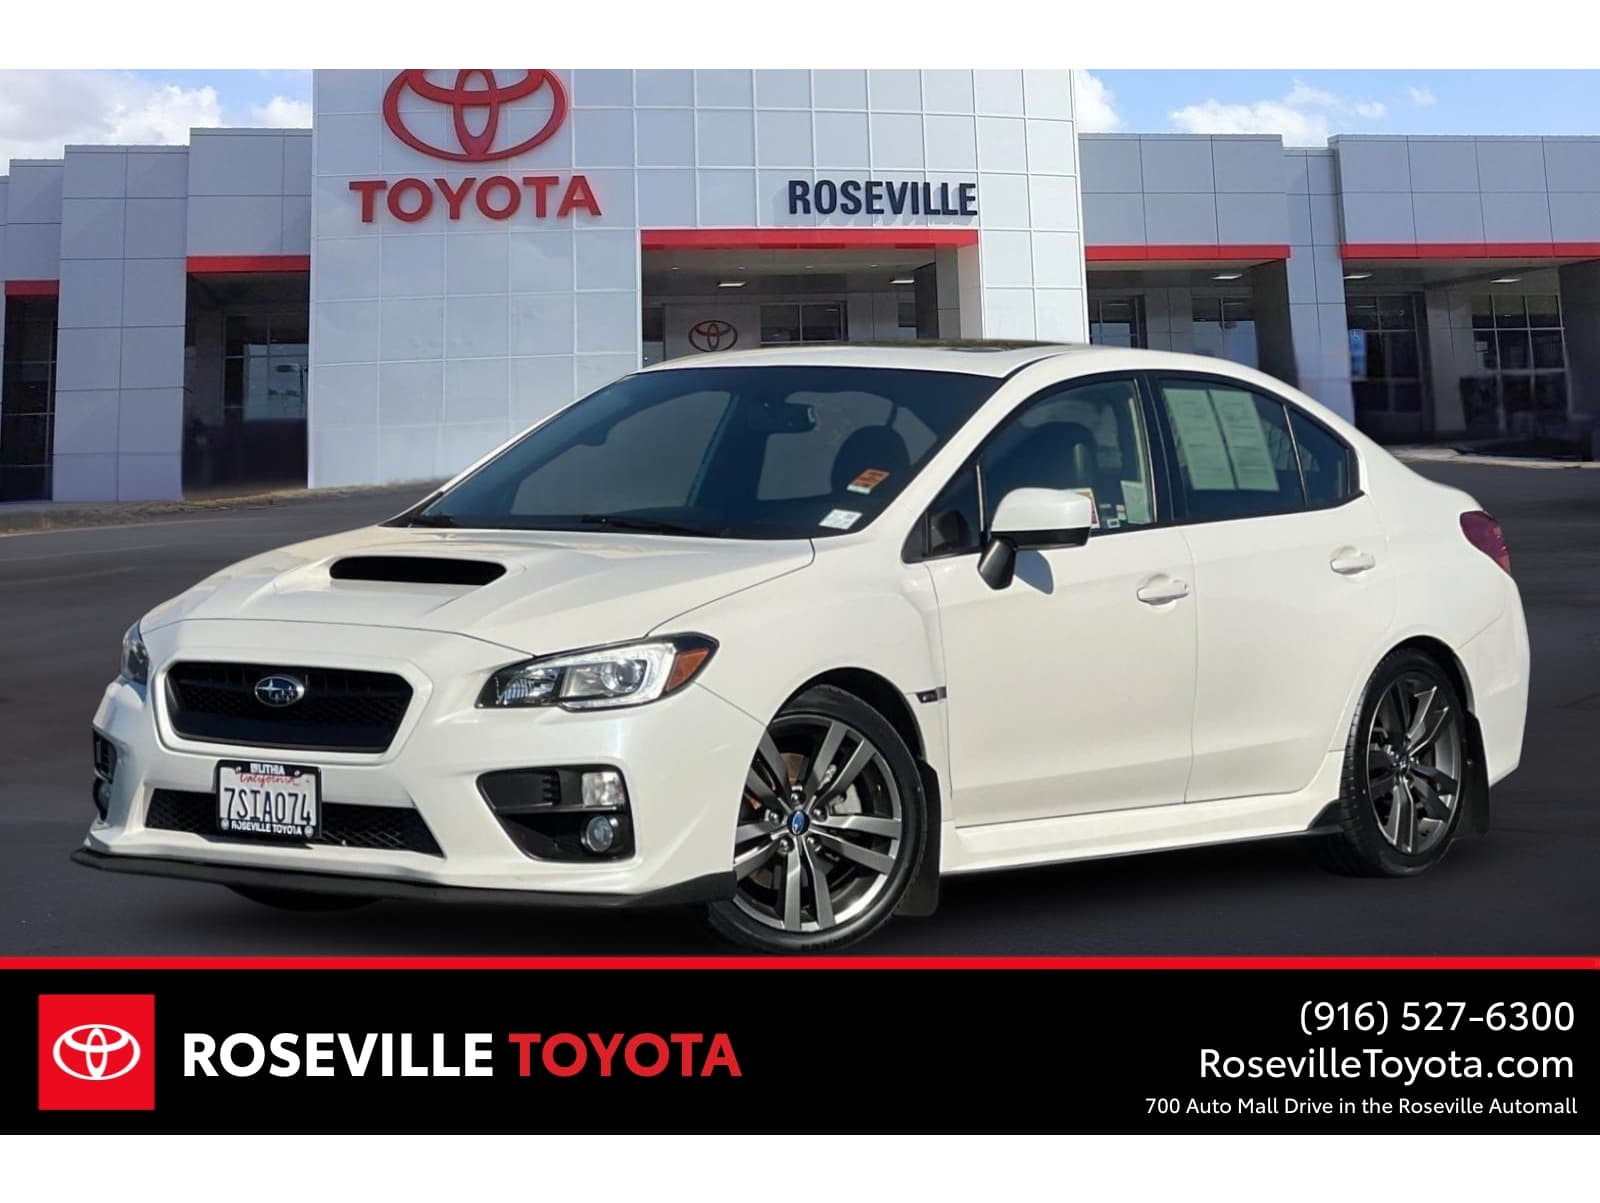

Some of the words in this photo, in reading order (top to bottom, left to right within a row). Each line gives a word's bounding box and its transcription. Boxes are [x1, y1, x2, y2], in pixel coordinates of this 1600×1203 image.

[349, 175, 602, 223] TOYOTA
[788, 179, 978, 216] ROSEVILLE
[231, 820, 271, 833] ROSEVILLE
[272, 824, 303, 835] TOYOTA
